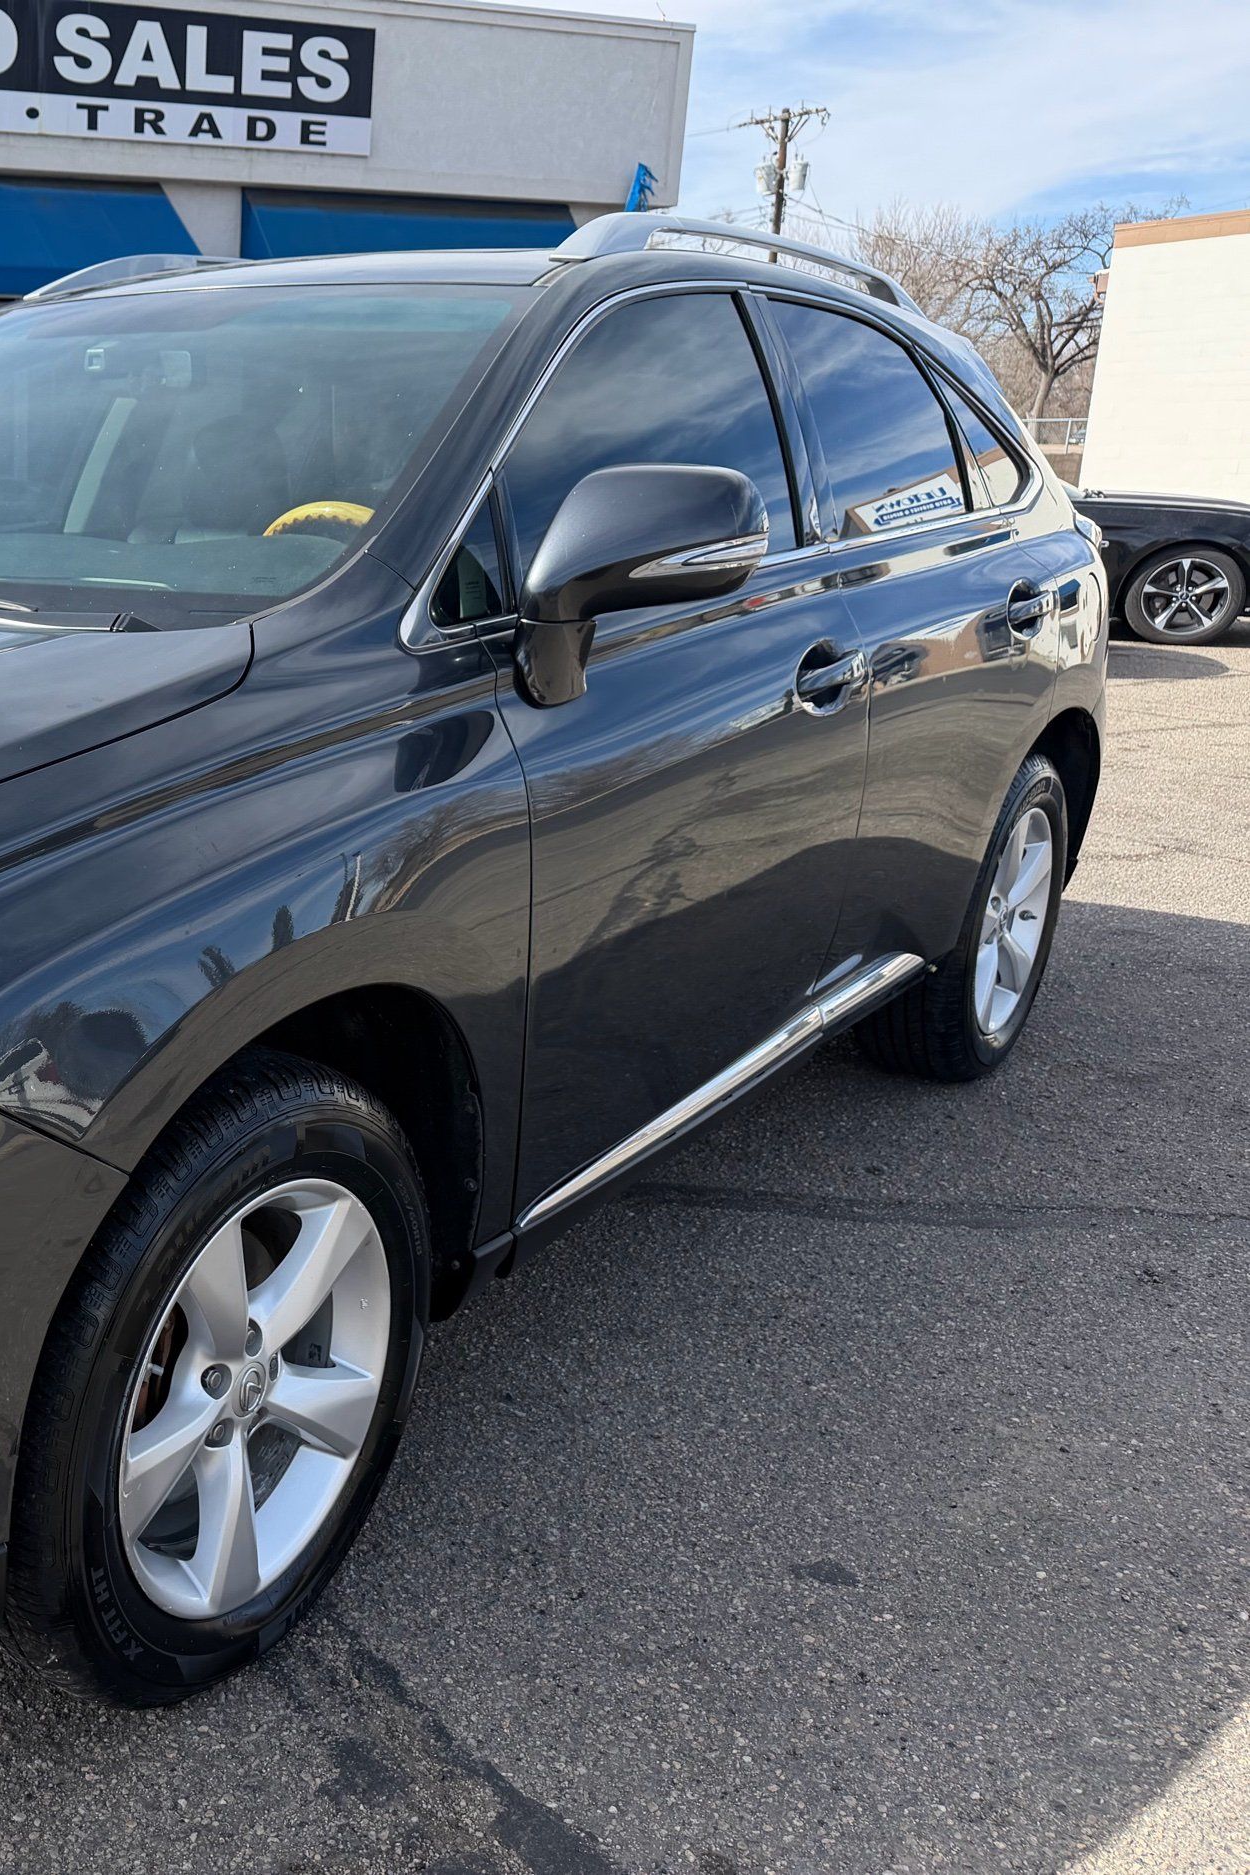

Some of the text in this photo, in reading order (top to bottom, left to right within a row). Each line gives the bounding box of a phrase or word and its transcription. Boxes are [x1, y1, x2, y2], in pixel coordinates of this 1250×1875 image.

[53, 13, 352, 104] SALES
[76, 102, 329, 147] TRADE
[90, 1566, 145, 1662] X FIT HT
